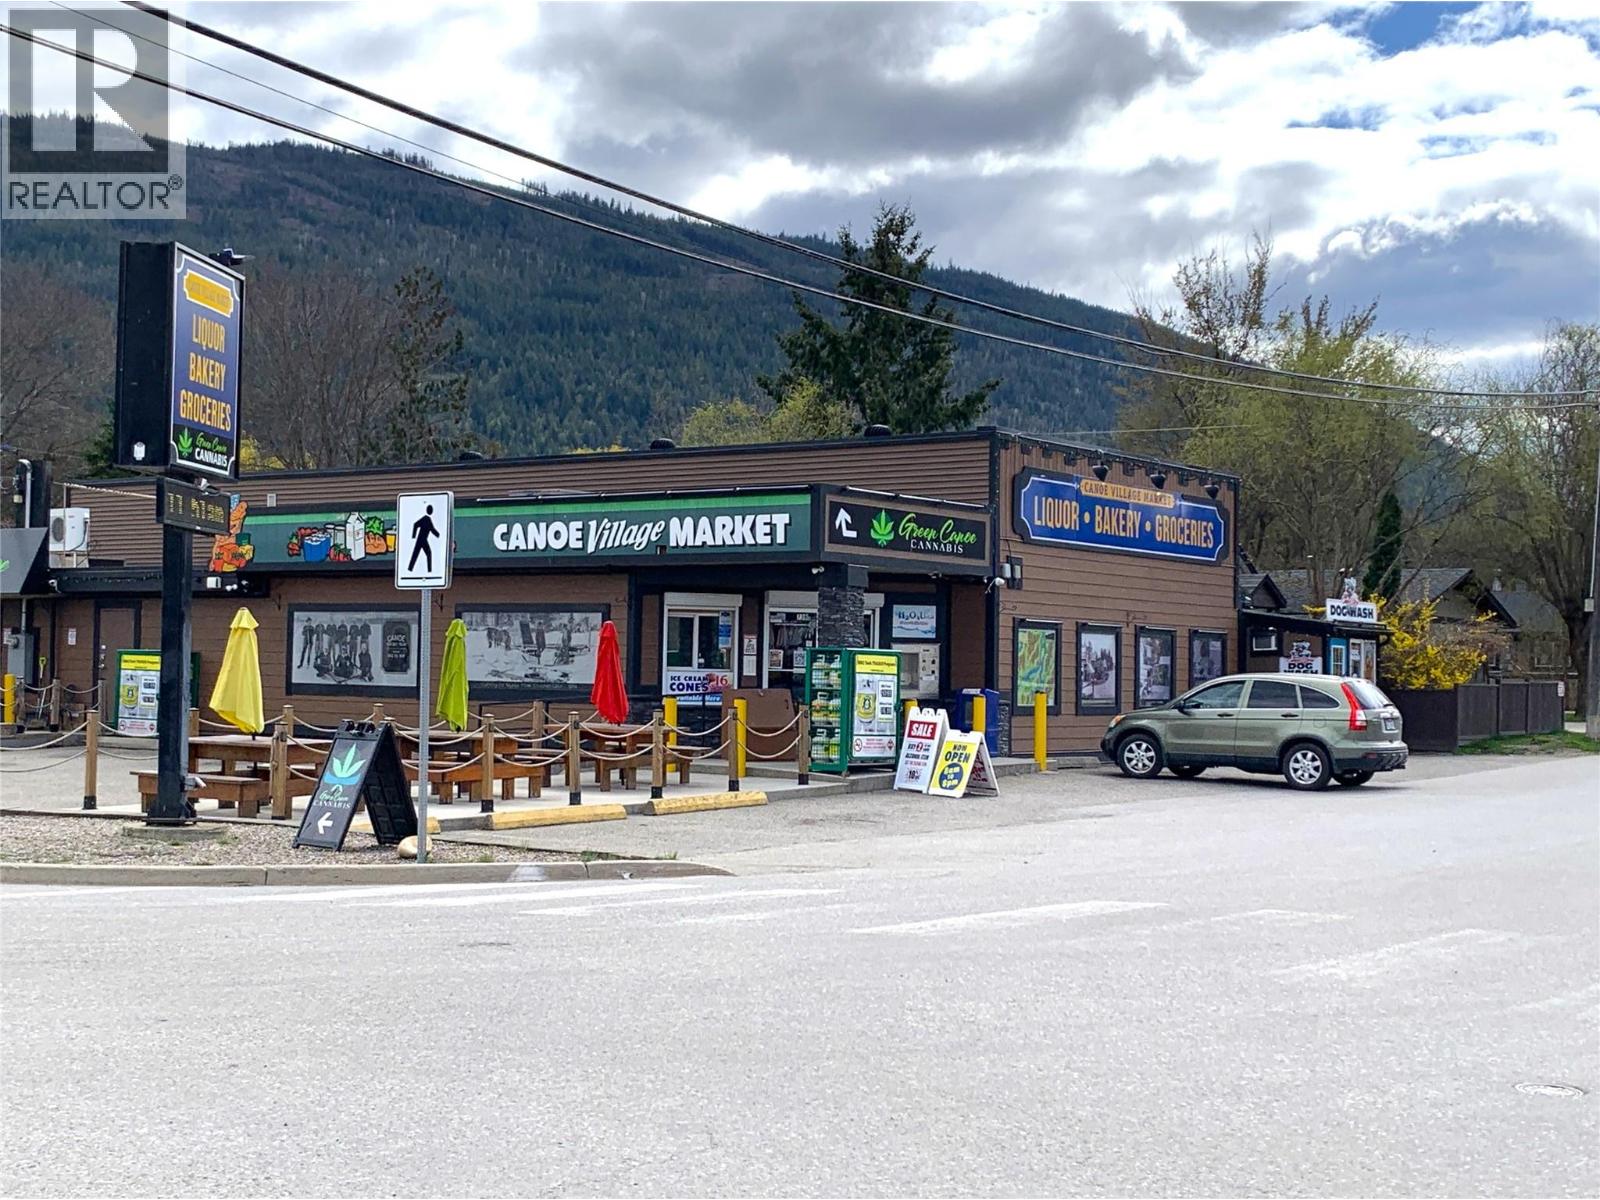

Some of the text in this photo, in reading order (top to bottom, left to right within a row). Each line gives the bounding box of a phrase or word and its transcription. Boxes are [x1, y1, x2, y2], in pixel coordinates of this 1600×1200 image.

[192, 314, 225, 353] LIQUOR
[189, 352, 226, 391] BAKERY
[180, 389, 231, 432] GROCERIES
[195, 448, 227, 467] CANNABIS
[1084, 482, 1171, 506] CANOE VILLAGE MARKET
[493, 513, 790, 554] CANOE Village MARKET
[899, 513, 977, 544] Green Canoe
[1034, 496, 1214, 548] LIQUOR BAKERY GROCERIES
[911, 539, 963, 554] CANNABIS
[669, 682, 709, 692] CONES
[911, 723, 934, 737] SALE
[944, 751, 971, 763] OPEN
[313, 800, 351, 809] CANNABIS
